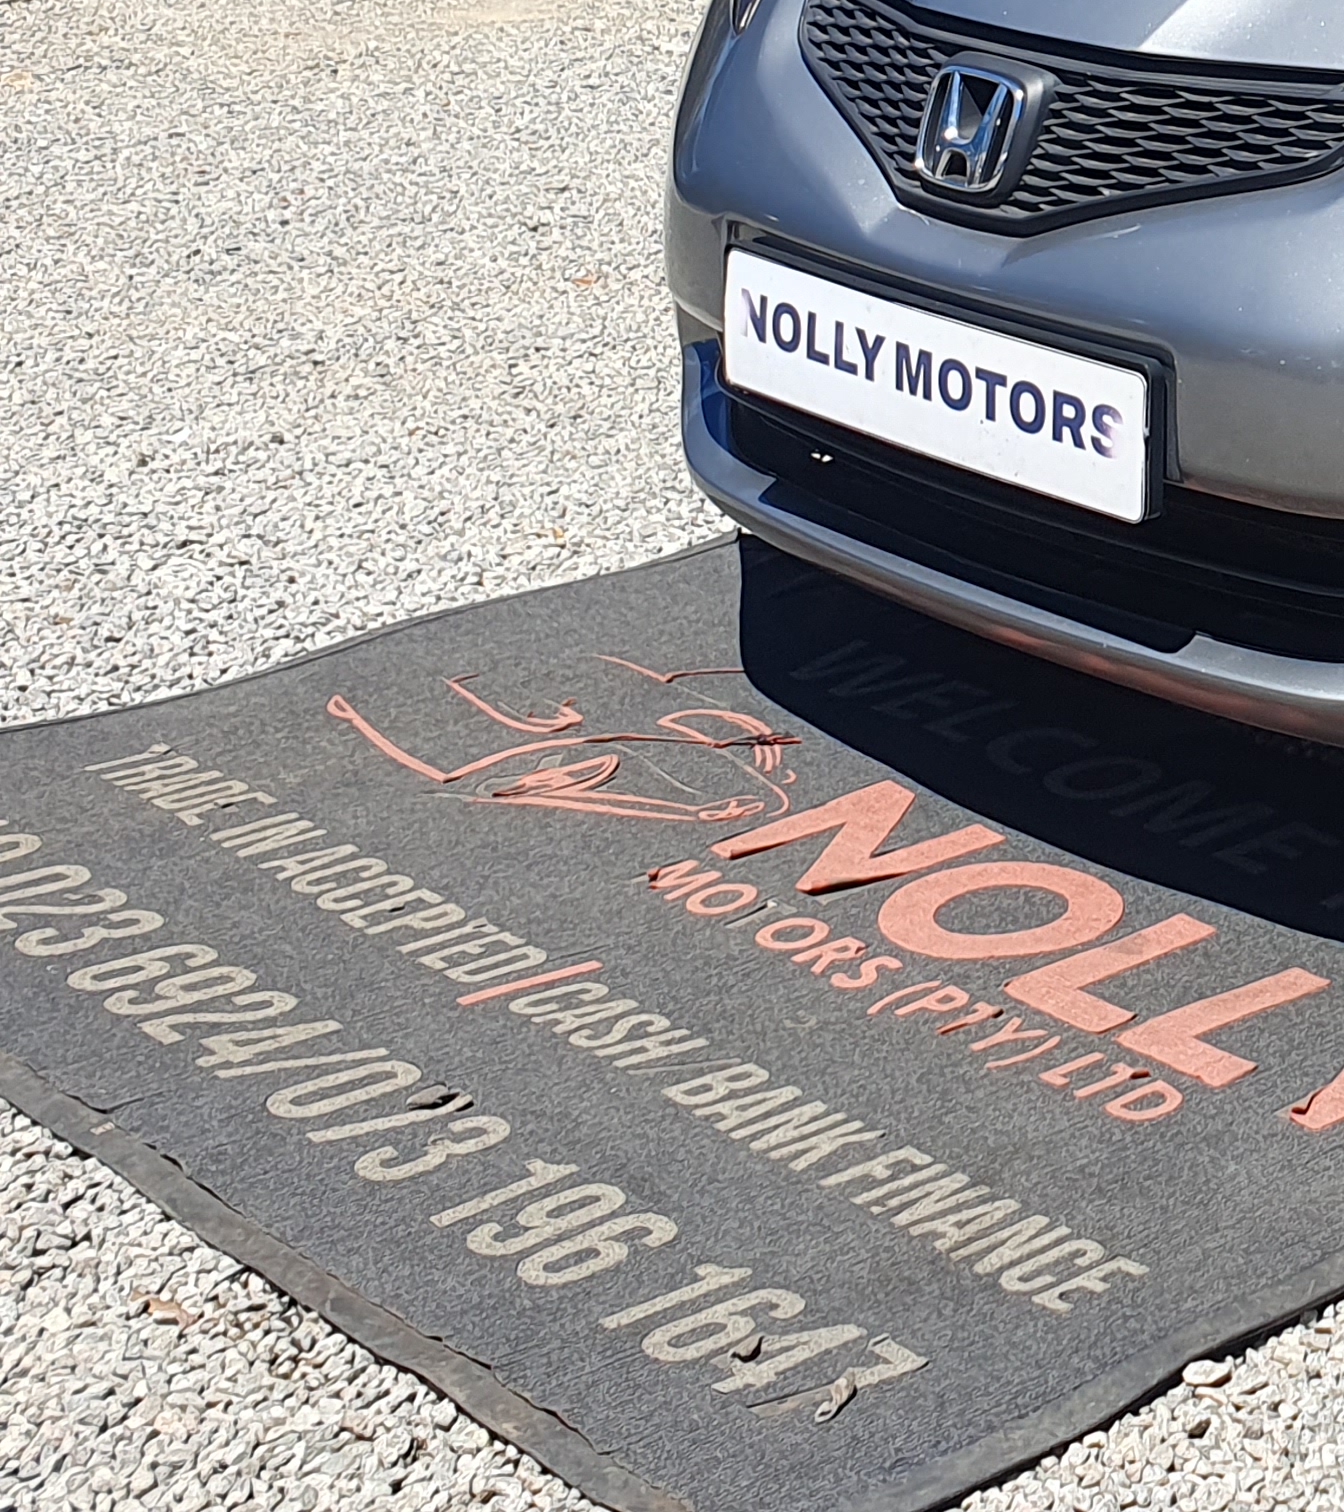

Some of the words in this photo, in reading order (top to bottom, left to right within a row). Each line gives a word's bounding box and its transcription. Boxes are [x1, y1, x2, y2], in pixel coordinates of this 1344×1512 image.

[741, 288, 886, 382] NOLLY
[895, 340, 1124, 459] MOTORS
[789, 639, 1342, 876] WELCOME
[84, 743, 278, 826] TRADE
[209, 812, 328, 858] IN
[819, 1144, 1150, 1314] FINANCE
[647, 859, 903, 989] MOTORS
[866, 980, 1061, 1070] (PTY)
[1038, 1051, 1184, 1121] LTD
[429, 1158, 679, 1286] 196
[600, 1262, 930, 1424] 1647
